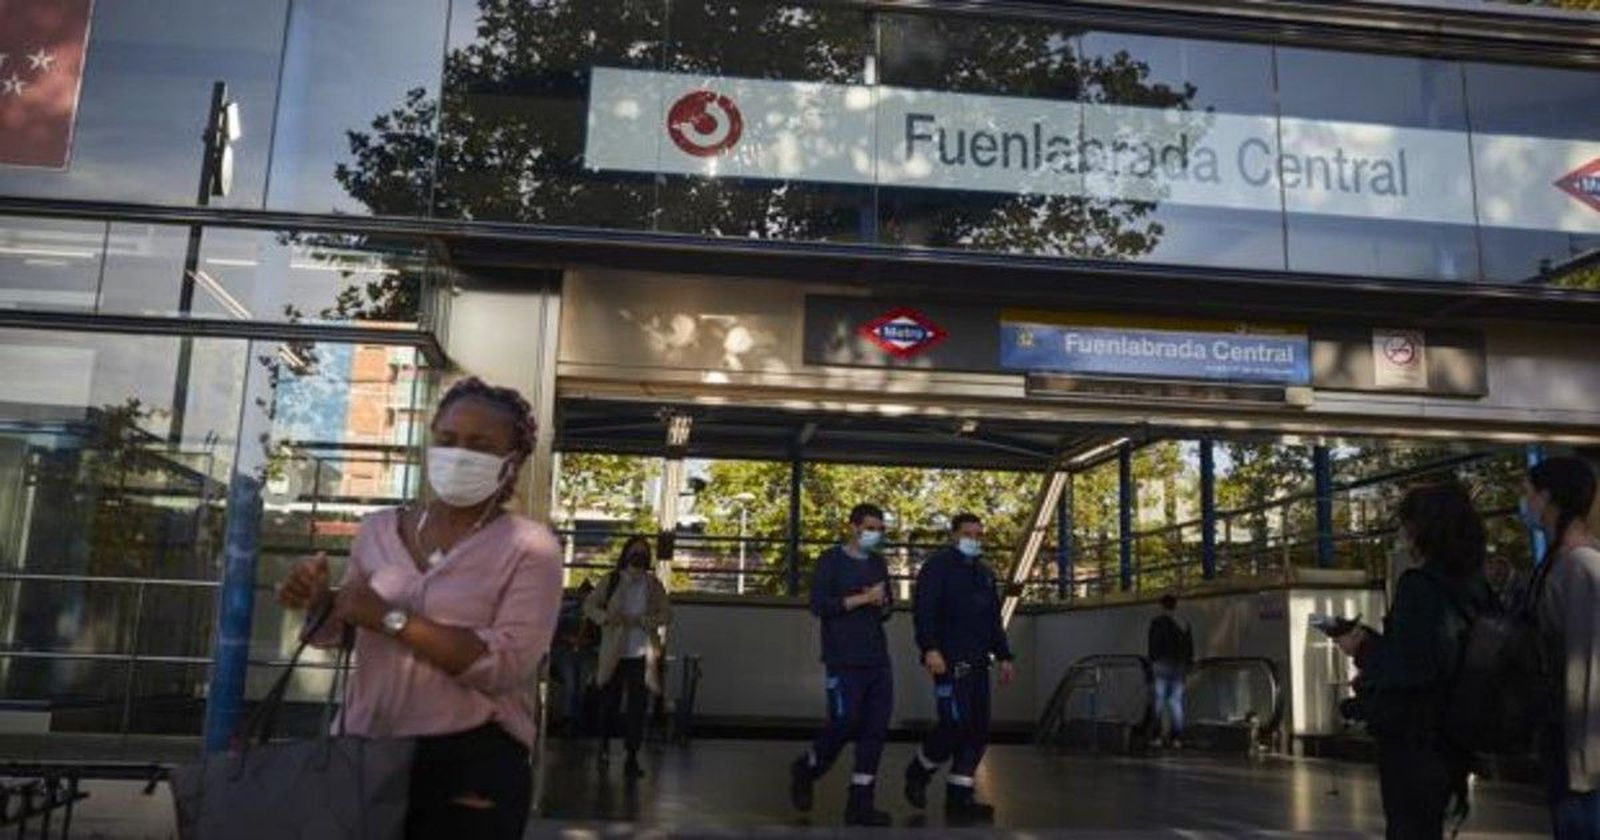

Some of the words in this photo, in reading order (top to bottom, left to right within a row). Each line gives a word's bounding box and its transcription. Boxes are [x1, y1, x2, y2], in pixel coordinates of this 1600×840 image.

[904, 112, 1220, 184] Fuenlabrada
[1237, 136, 1409, 197] Central
[883, 325, 924, 340] Metro
[1064, 332, 1206, 360] Fuenlabrada
[1212, 340, 1294, 363] Central
